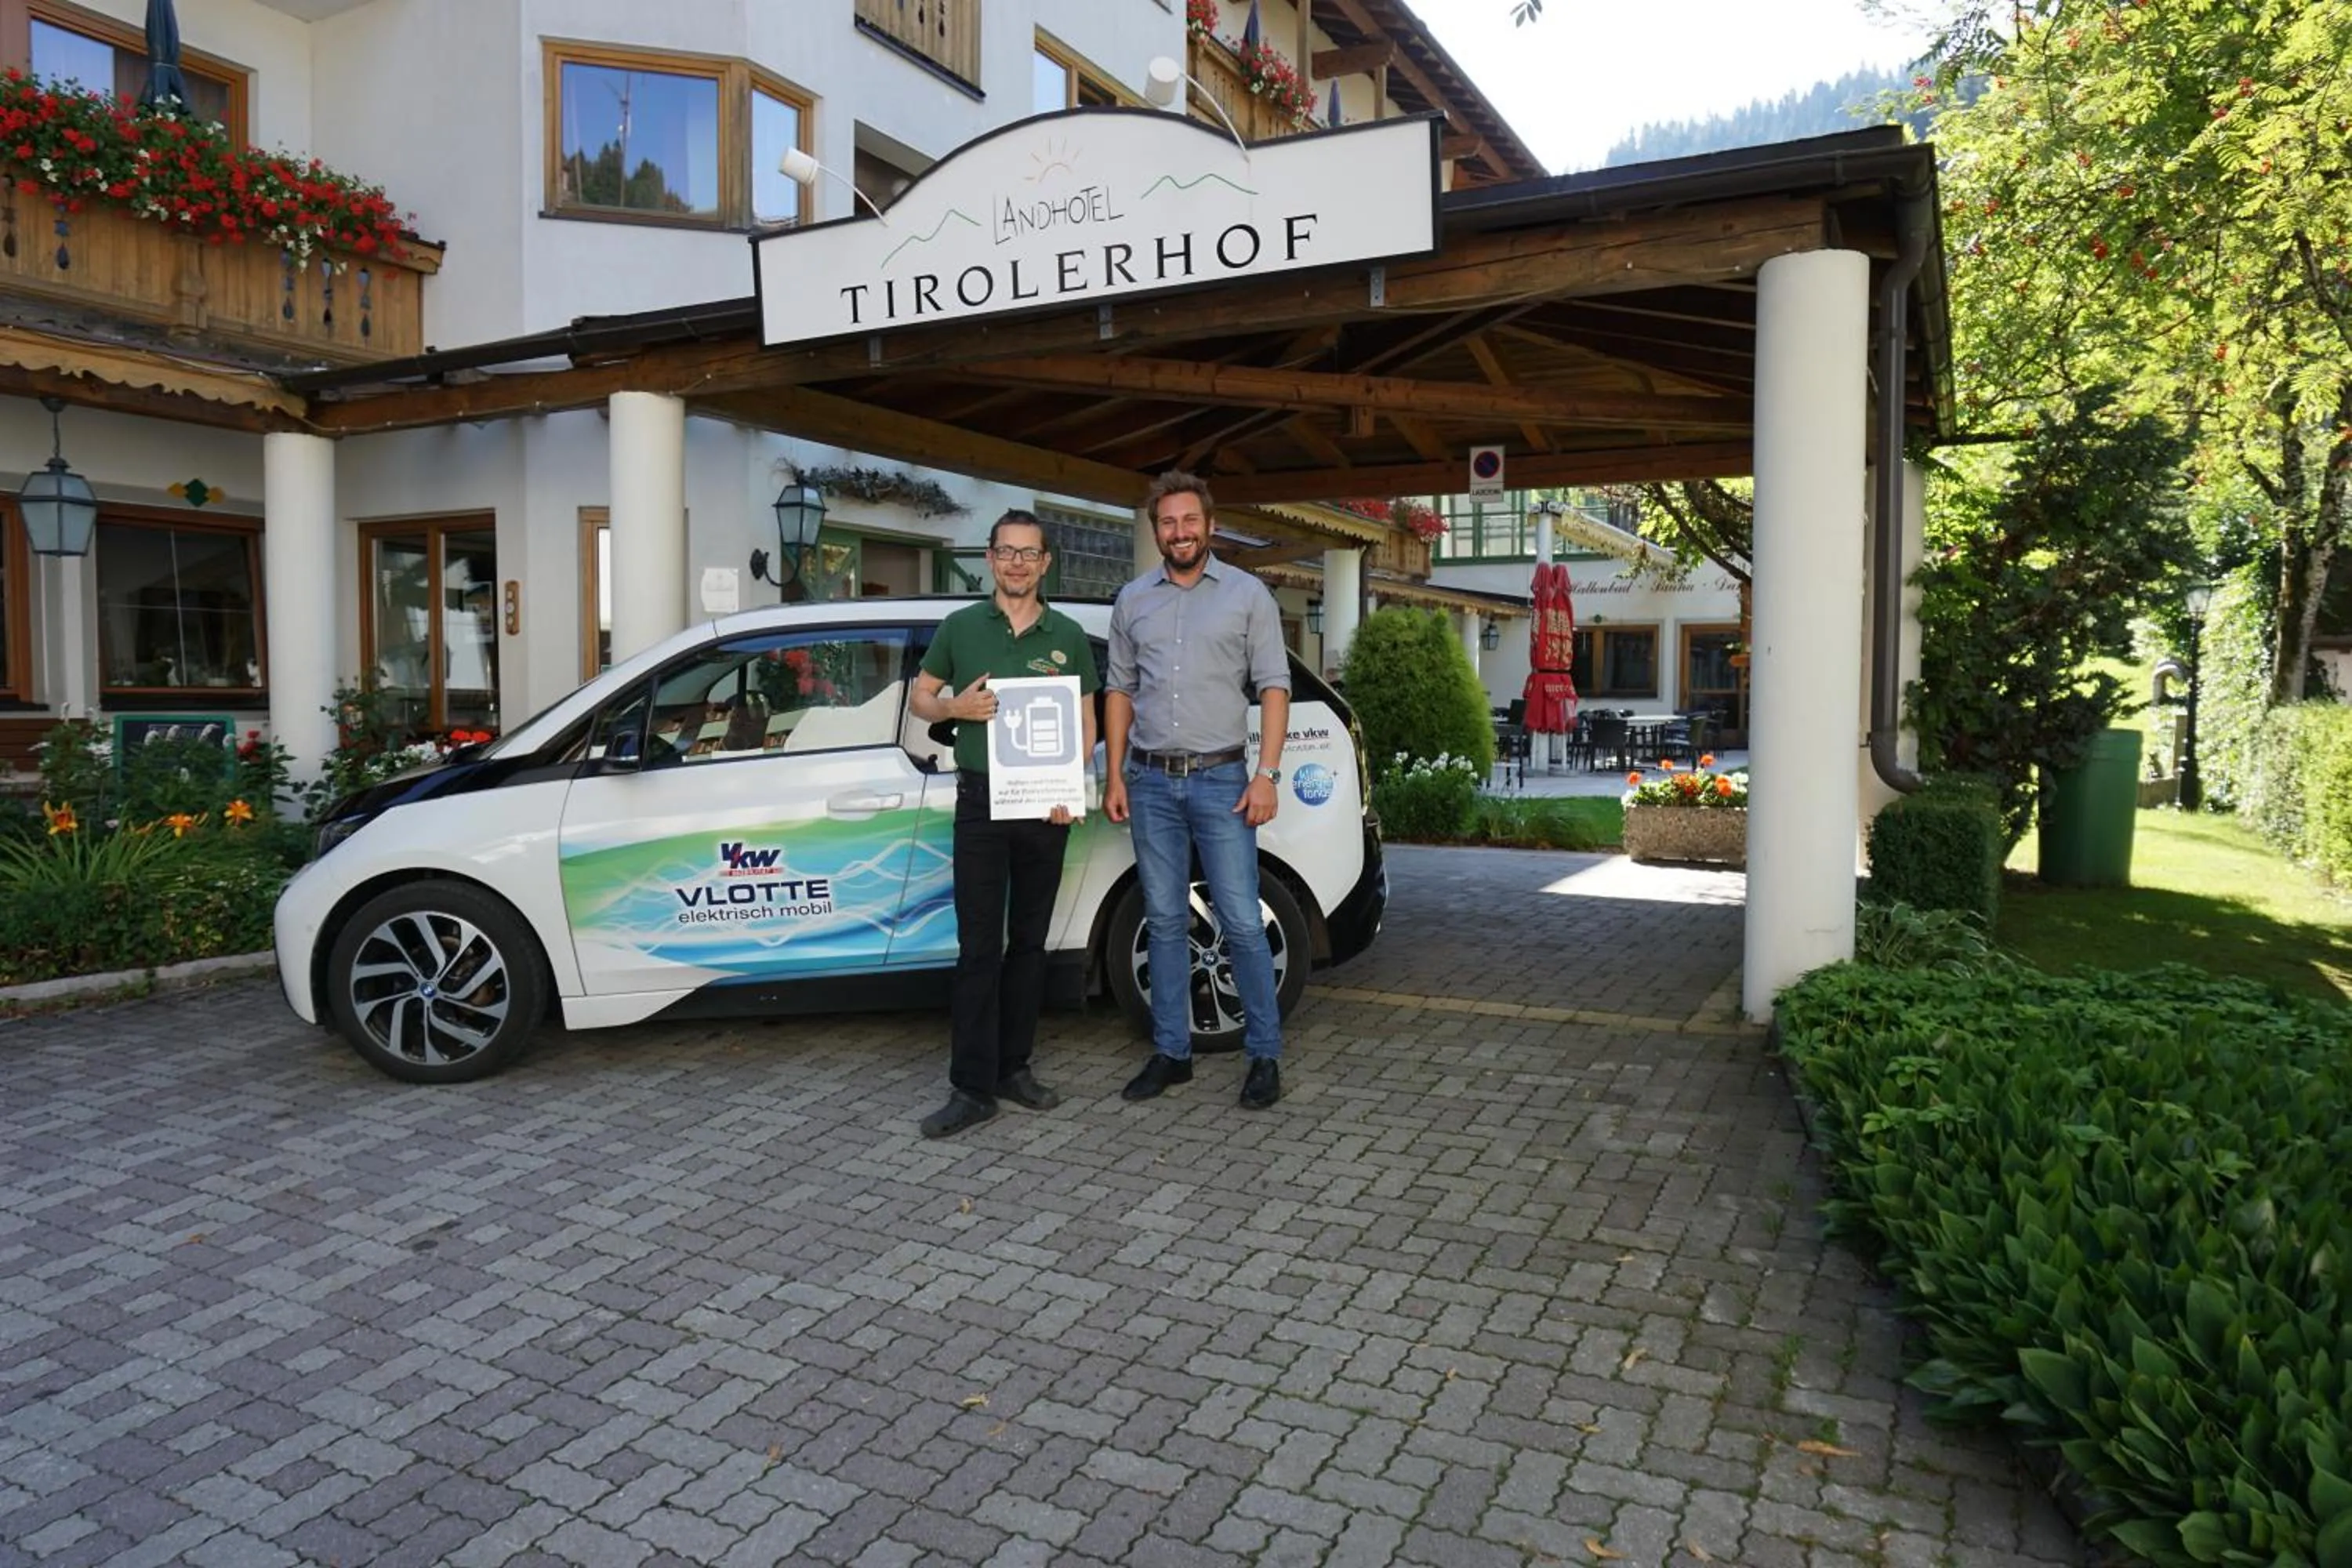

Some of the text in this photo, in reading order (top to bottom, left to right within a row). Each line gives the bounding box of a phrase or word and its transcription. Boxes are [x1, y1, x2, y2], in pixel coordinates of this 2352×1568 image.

[993, 186, 1125, 245] LANDHOTEL
[840, 214, 1318, 324] TIROLERHOF
[675, 880, 829, 907] VLOTTE
[678, 902, 832, 924] elektrisch mobil
